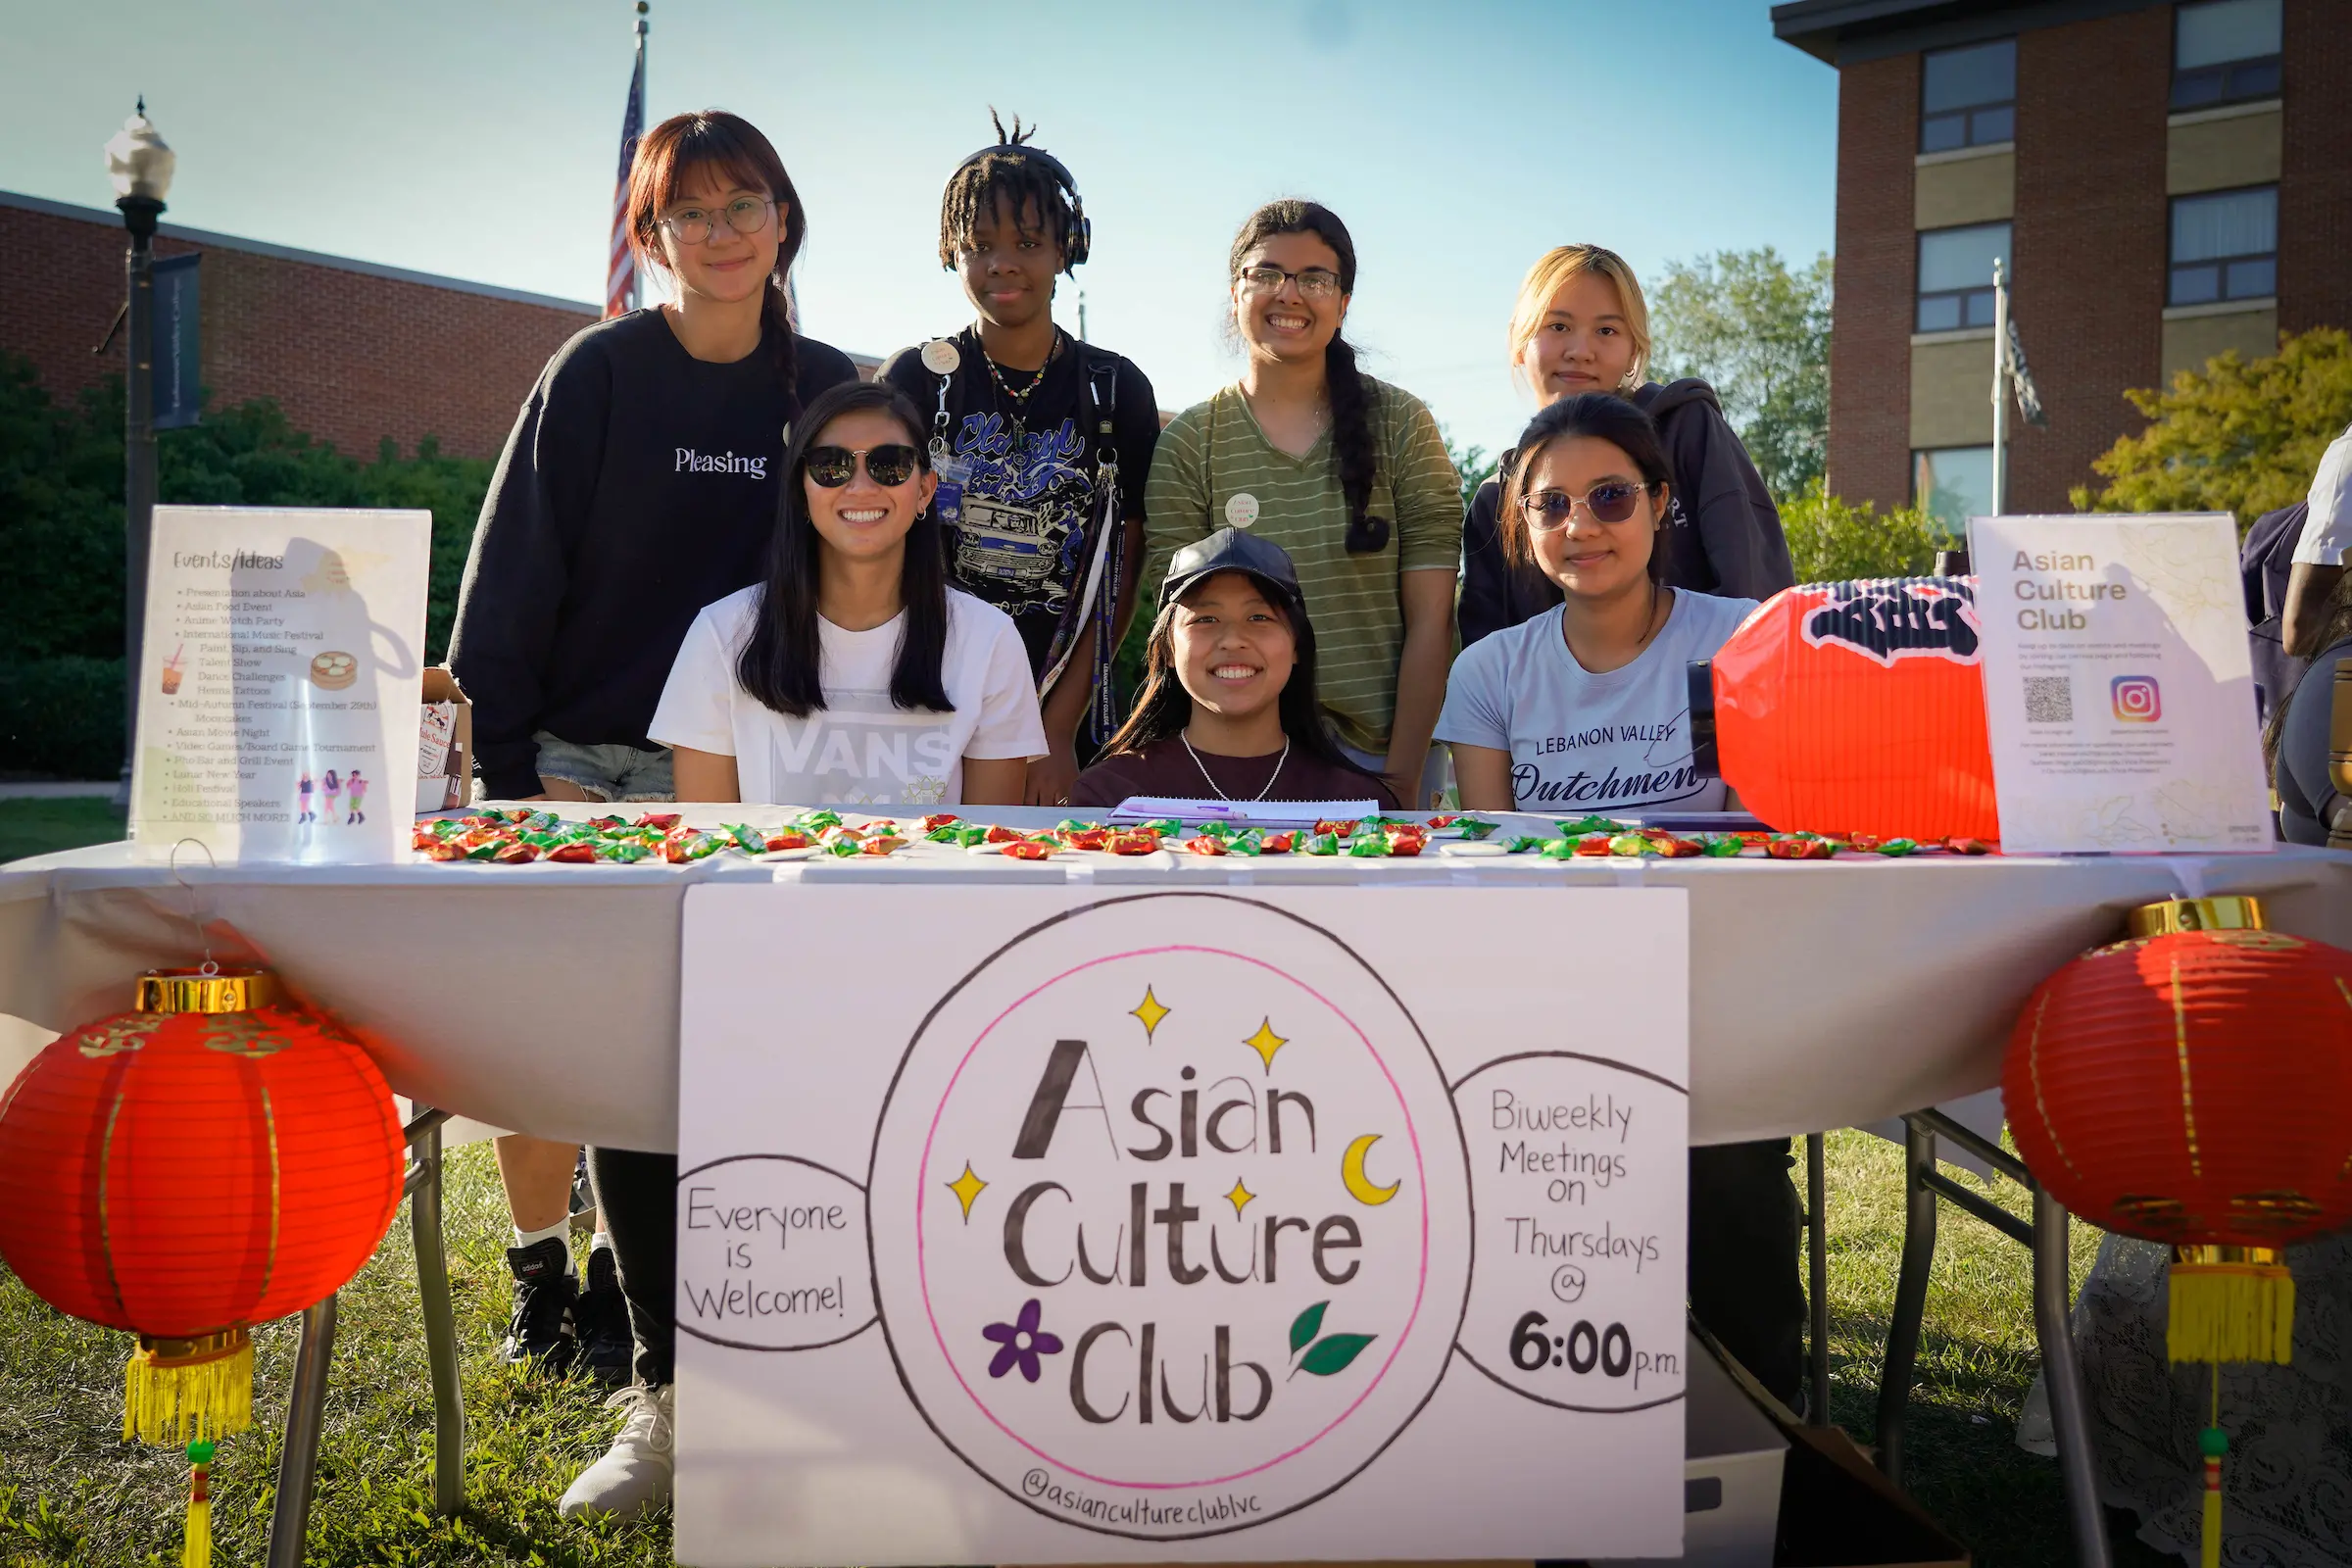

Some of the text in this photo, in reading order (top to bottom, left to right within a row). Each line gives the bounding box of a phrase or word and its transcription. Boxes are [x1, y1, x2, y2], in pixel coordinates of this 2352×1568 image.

[674, 447, 768, 480] Pleasing
[173, 549, 283, 572] Events/Ideas
[2013, 550, 2094, 572] Asian
[186, 589, 306, 598] Presentation about Asia
[2015, 580, 2127, 602] Culture
[184, 603, 272, 612] Asian Food Event
[184, 616, 284, 626] Anime Watch Party
[2017, 609, 2086, 631] Club
[183, 630, 323, 640] International Music Festival
[199, 658, 262, 667] Talent Show
[253, 644, 271, 654] and
[274, 644, 297, 654] Sing
[198, 672, 286, 682] Dance Challenges
[196, 714, 253, 723] Mooncakes
[176, 728, 270, 738] Asian Movie Night
[1536, 724, 1677, 756] LEBANON VALLEY
[768, 717, 954, 778] VANS
[172, 770, 257, 779] Lunar New Year
[1512, 763, 1697, 802] Dutchmen
[172, 799, 280, 809] Educational Speakers
[1011, 1039, 1317, 1162] Asian
[1492, 1090, 1633, 1144] Biweekly
[1499, 1141, 1627, 1189] Meetings
[1546, 1179, 1586, 1205] on
[688, 1187, 848, 1250] Everyone
[1003, 1181, 1362, 1287] Culture
[1505, 1216, 1659, 1274] Thursdays
[726, 1240, 753, 1269] is
[1550, 1264, 1586, 1302] @
[684, 1276, 845, 1320] Welcome!
[1509, 1310, 1632, 1378] 6:00
[1069, 1321, 1272, 1425] Club
[1022, 1468, 1262, 1525] @asiancultureclublvc
